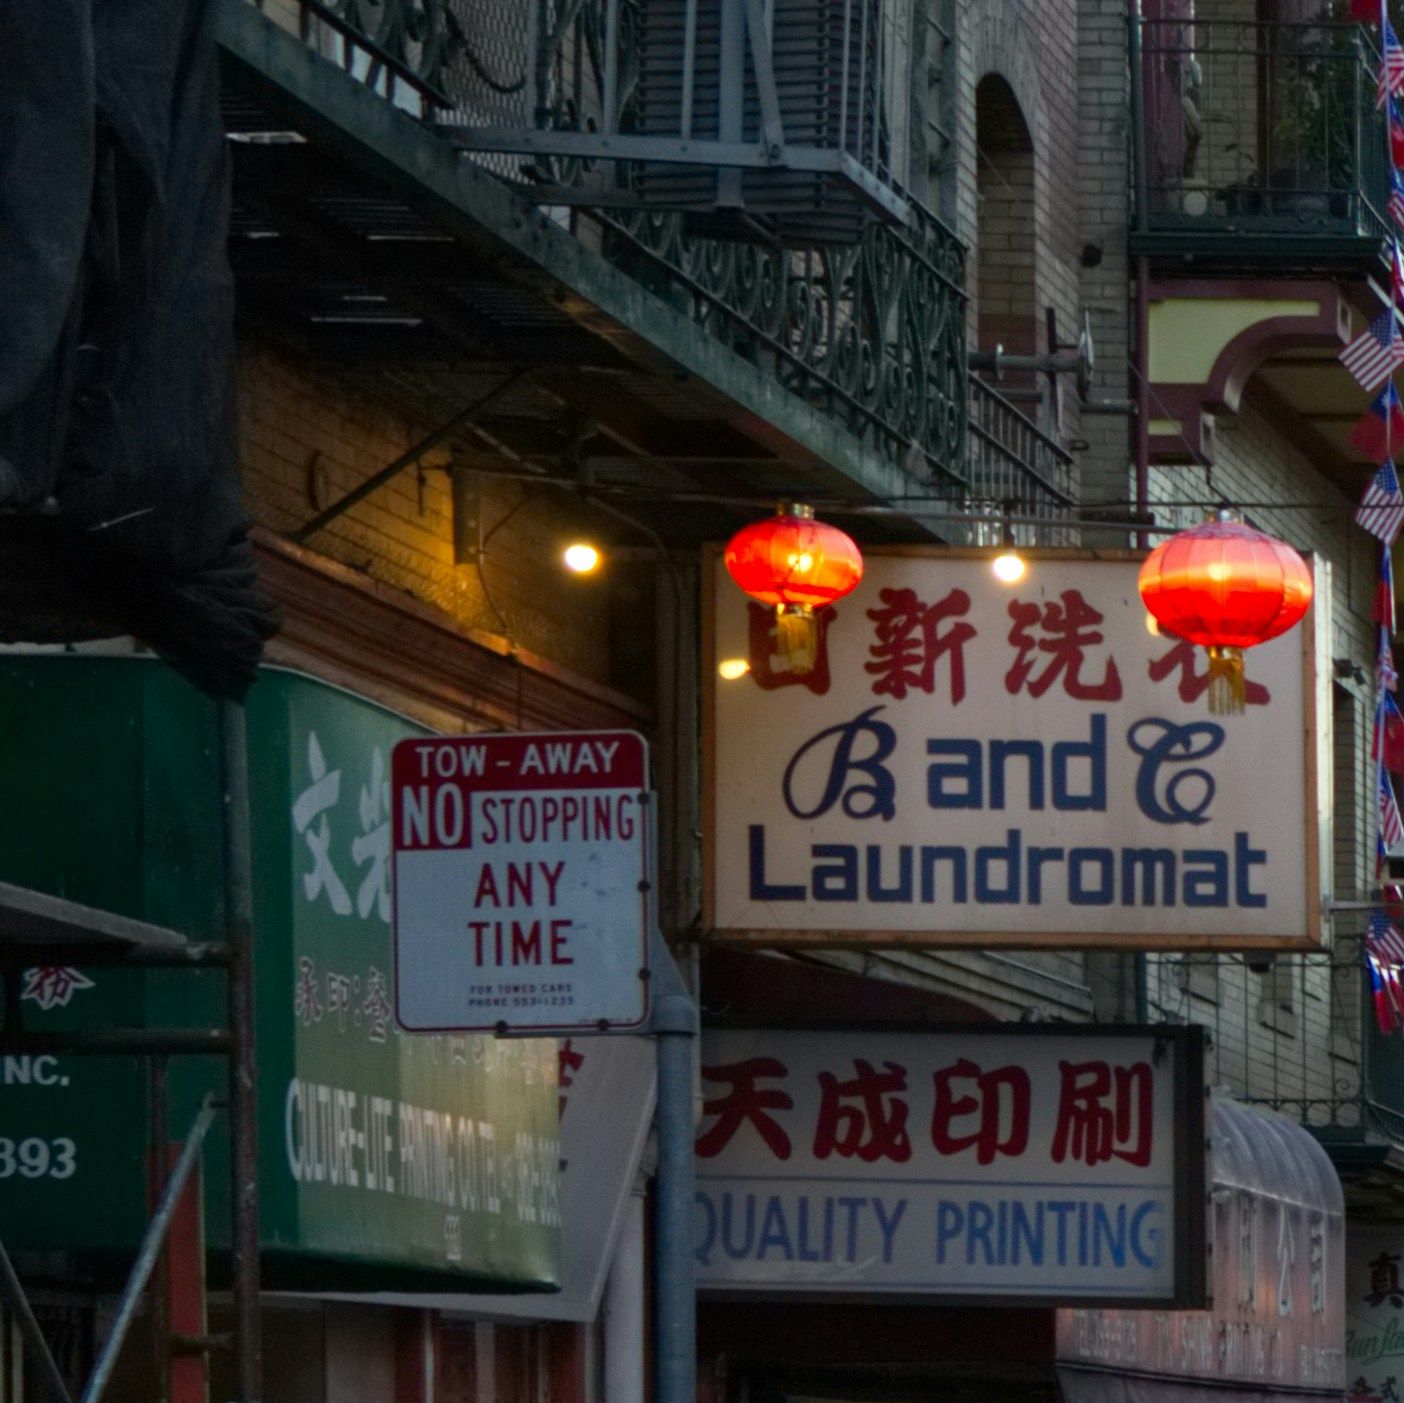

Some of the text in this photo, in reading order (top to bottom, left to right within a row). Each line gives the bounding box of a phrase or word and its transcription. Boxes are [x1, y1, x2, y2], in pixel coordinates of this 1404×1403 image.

[783, 705, 897, 821] B
[927, 713, 1107, 812] and
[402, 784, 635, 847] NO STOPPING
[473, 861, 566, 908] ANY
[748, 824, 1268, 909] Laundromat
[468, 920, 574, 967] TIME
[469, 997, 507, 1008] PHONE
[470, 983, 572, 995] FOR TOWED CARS
[0, 1055, 71, 1087] NC.
[694, 1057, 1154, 1167] 天成印刷
[694, 1196, 1164, 1269] QUALITY PRINTING
